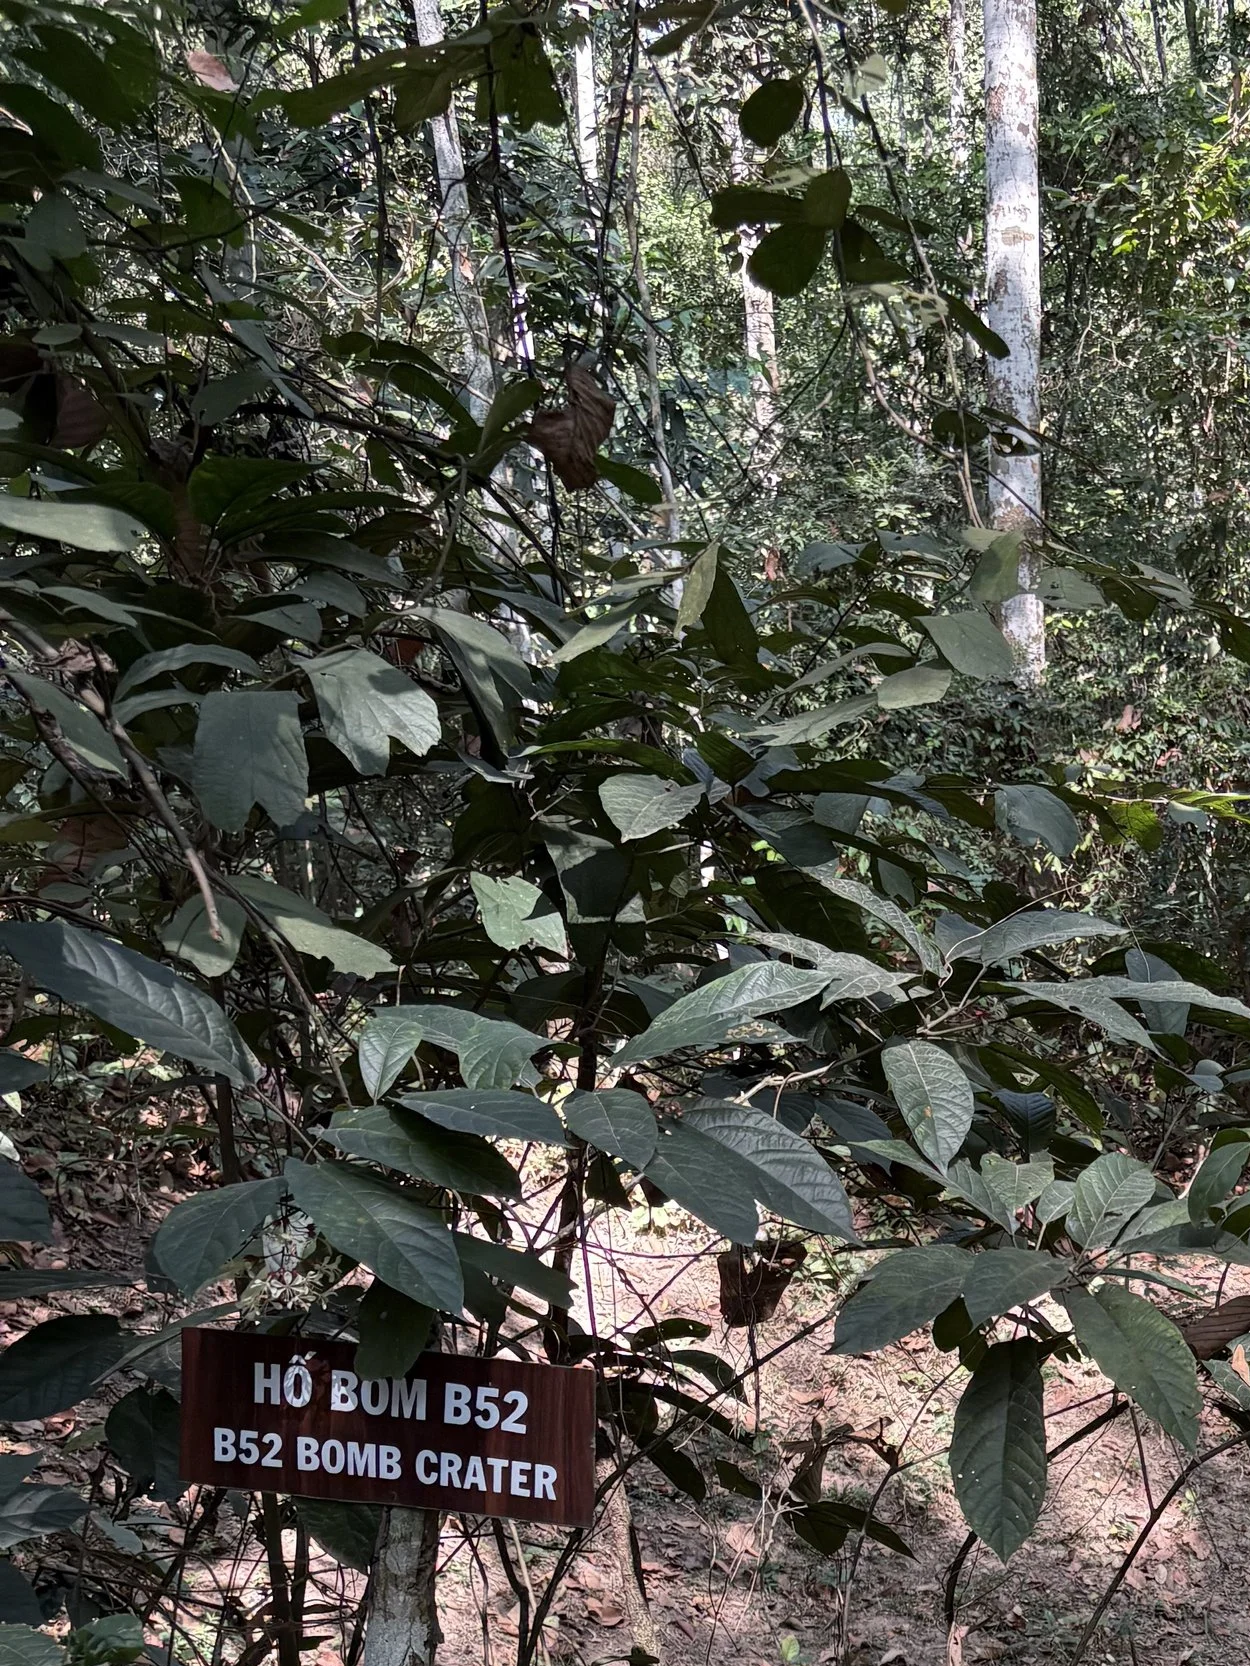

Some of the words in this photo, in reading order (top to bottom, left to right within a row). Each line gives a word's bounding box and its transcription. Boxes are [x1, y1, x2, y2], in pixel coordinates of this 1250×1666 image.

[253, 1351, 316, 1408] HỐ
[330, 1369, 427, 1421] BOM
[444, 1382, 529, 1434] B52
[213, 1427, 283, 1468] B52
[296, 1436, 402, 1480] BOMB
[415, 1449, 558, 1500] CRATER
